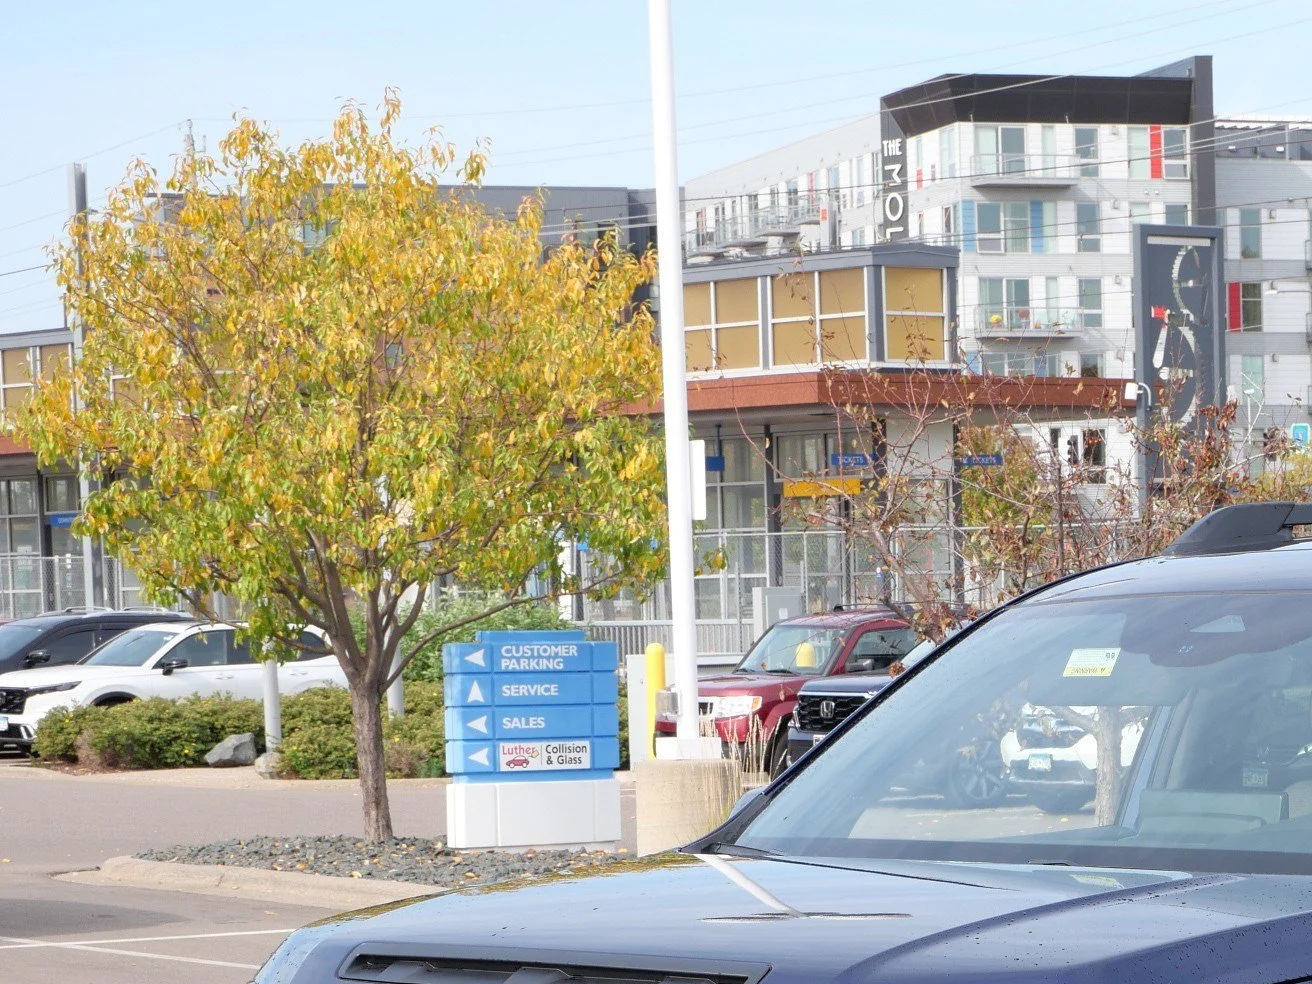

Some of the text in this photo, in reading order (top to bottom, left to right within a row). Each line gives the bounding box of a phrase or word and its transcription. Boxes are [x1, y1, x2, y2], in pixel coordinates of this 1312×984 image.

[882, 138, 902, 156] THE
[501, 645, 578, 657] CUSTOMER
[500, 658, 564, 670] PARKING
[502, 684, 559, 696] SERVICE
[502, 717, 545, 729] SALES
[502, 743, 588, 755] Luther Collision
[546, 754, 582, 765] & Glass
